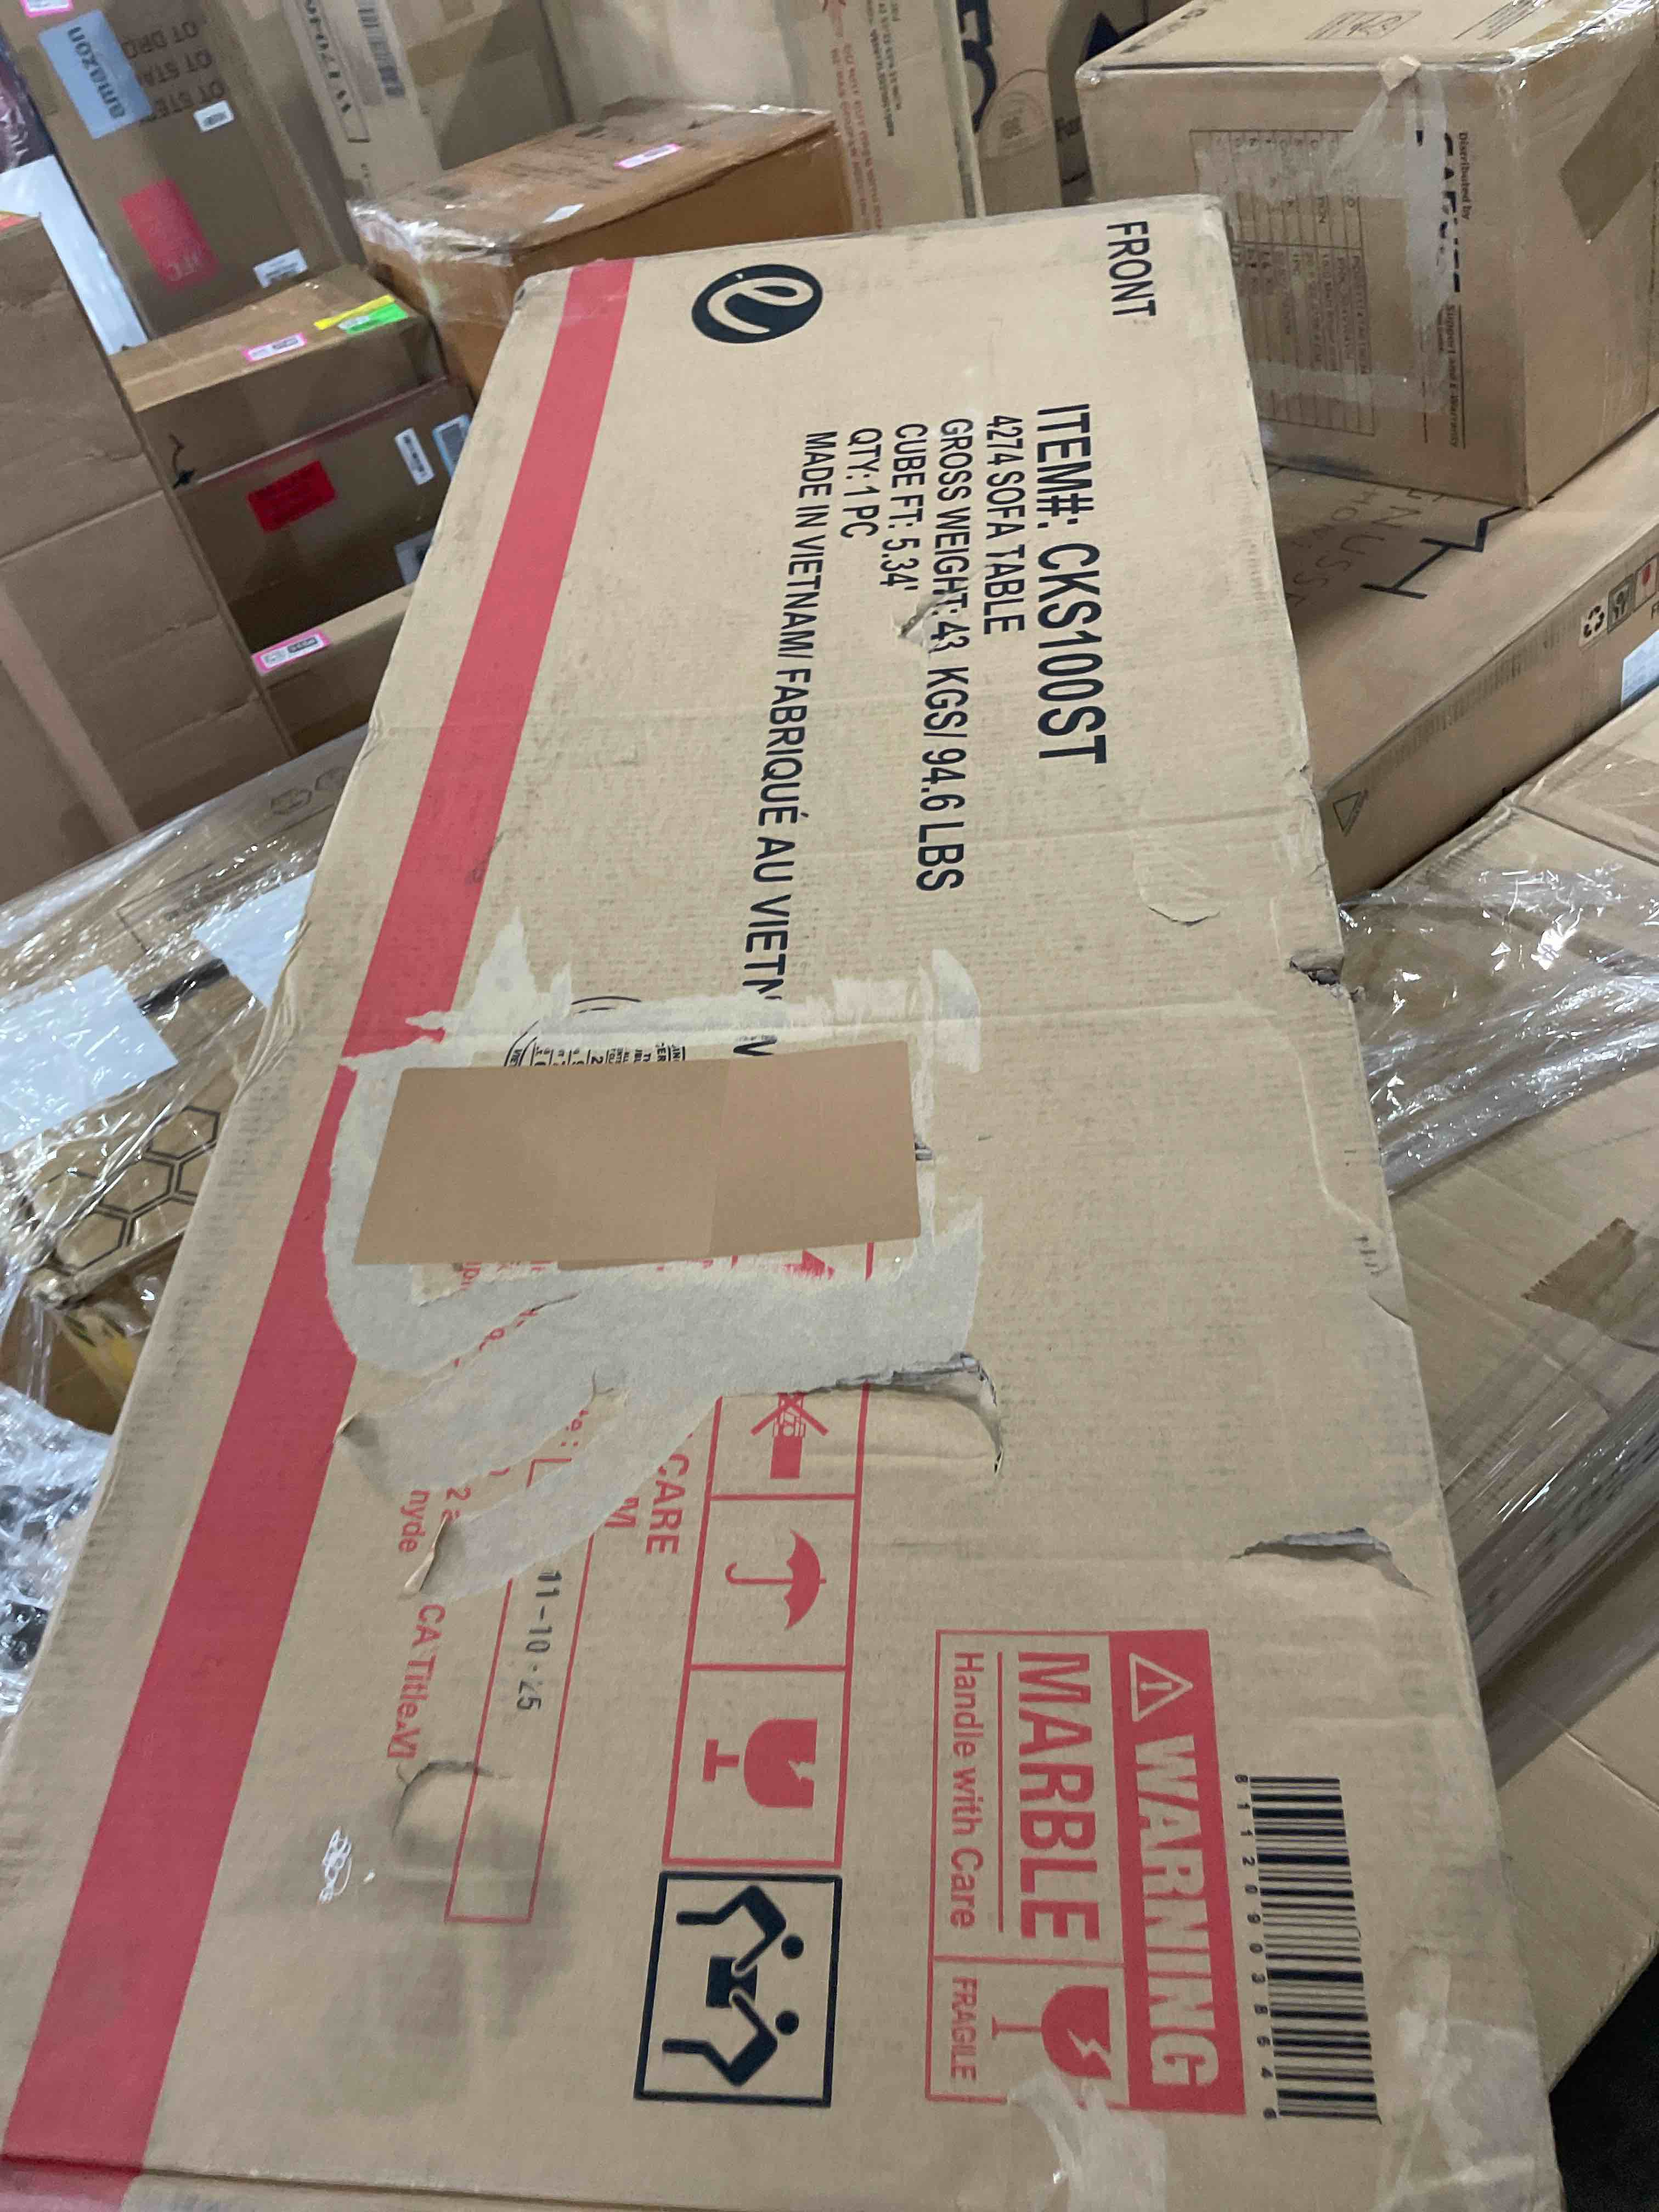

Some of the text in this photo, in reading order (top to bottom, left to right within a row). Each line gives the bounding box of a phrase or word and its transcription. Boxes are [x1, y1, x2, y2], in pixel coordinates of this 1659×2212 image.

[67, 26, 126, 119] amazon
[1459, 132, 1472, 221] Distributed by
[1107, 222, 1155, 315] FRONT
[799, 432, 837, 498] MADE
[841, 428, 882, 538] QTY: 1 PC
[892, 424, 927, 488] CUBE
[795, 505, 829, 527] IN
[889, 495, 923, 528] FT:
[984, 416, 1025, 634] 4274 SOFA TABLE
[778, 535, 825, 658] VIETNAM/
[1037, 404, 1106, 764] ITEM#: CKS100ST
[917, 419, 972, 890] GROSS WEIGHT: 43 KGS/ 94.6 LBS
[759, 669, 810, 826] FABRIQUÉ
[754, 837, 795, 882] AU
[647, 1454, 689, 1554] CARE
[951, 1653, 983, 1929] Handle with Care
[1018, 1652, 1099, 1940] MARBLE
[1134, 1735, 1218, 2085] WARNING
[951, 1978, 978, 2081] FRAGILE
